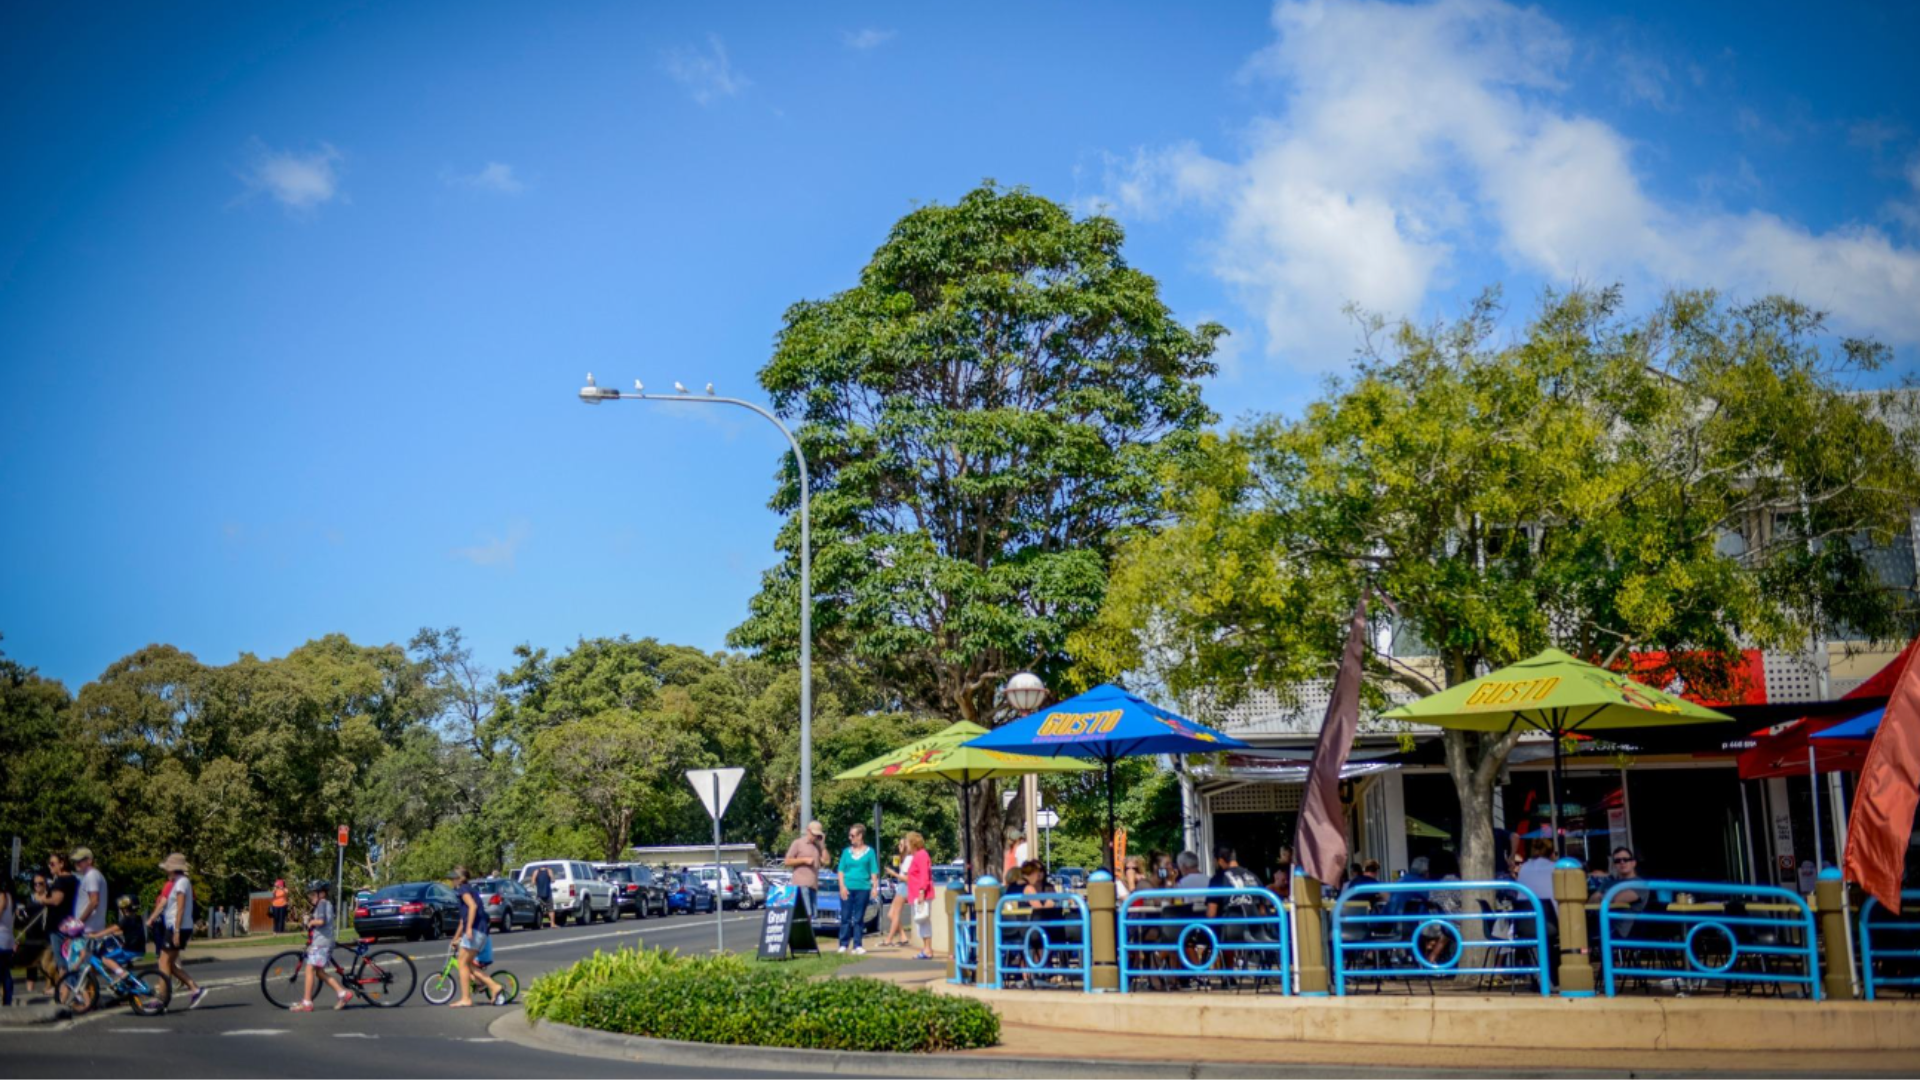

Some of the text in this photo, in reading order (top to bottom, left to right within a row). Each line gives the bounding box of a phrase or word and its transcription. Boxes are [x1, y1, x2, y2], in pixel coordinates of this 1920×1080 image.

[1466, 676, 1561, 705] GUSTO
[1037, 708, 1124, 736] GUSTO
[767, 910, 787, 924] Great
